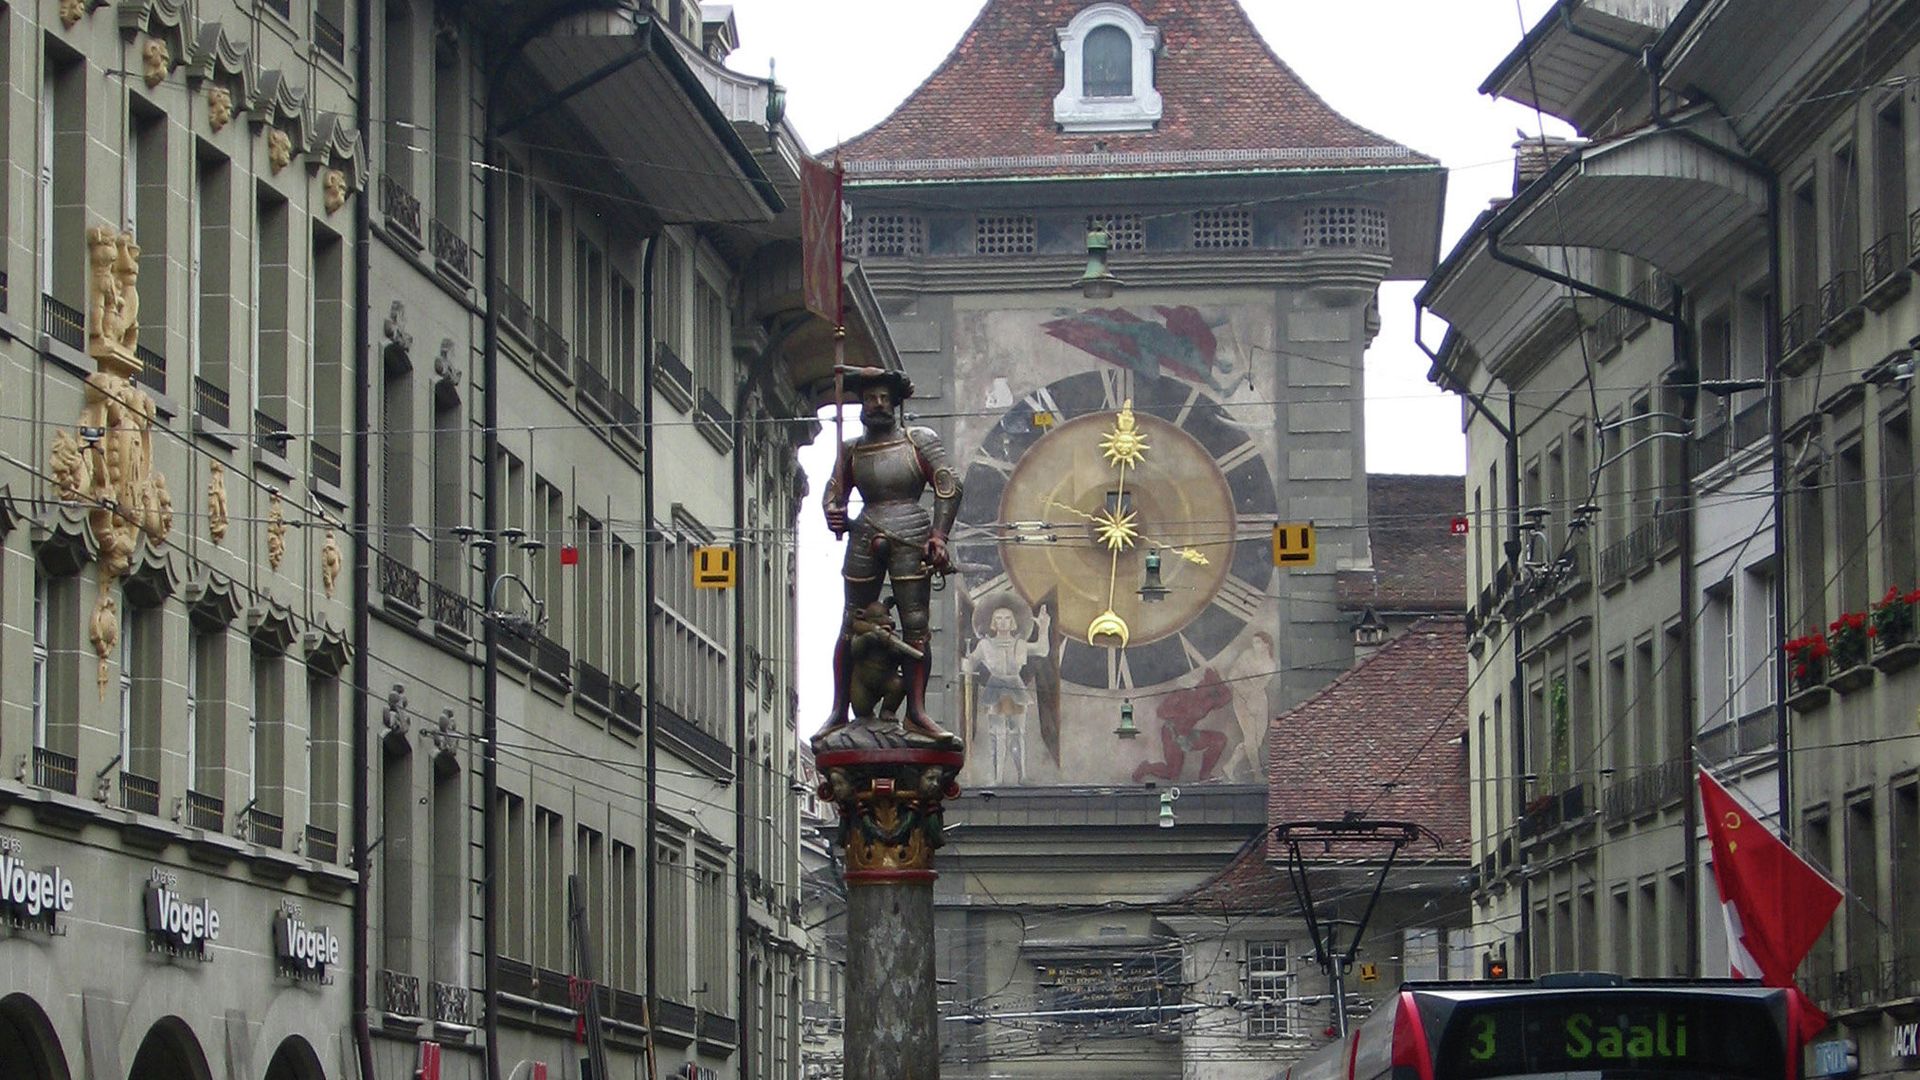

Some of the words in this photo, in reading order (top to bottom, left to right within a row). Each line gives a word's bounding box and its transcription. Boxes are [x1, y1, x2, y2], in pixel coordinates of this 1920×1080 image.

[0, 854, 74, 916] Vögele
[157, 888, 220, 944] Vögele
[286, 917, 339, 968] Vögele
[1470, 1014, 1496, 1060] 3
[1566, 1012, 1687, 1058] Saali
[1891, 1023, 1919, 1057] JACK
